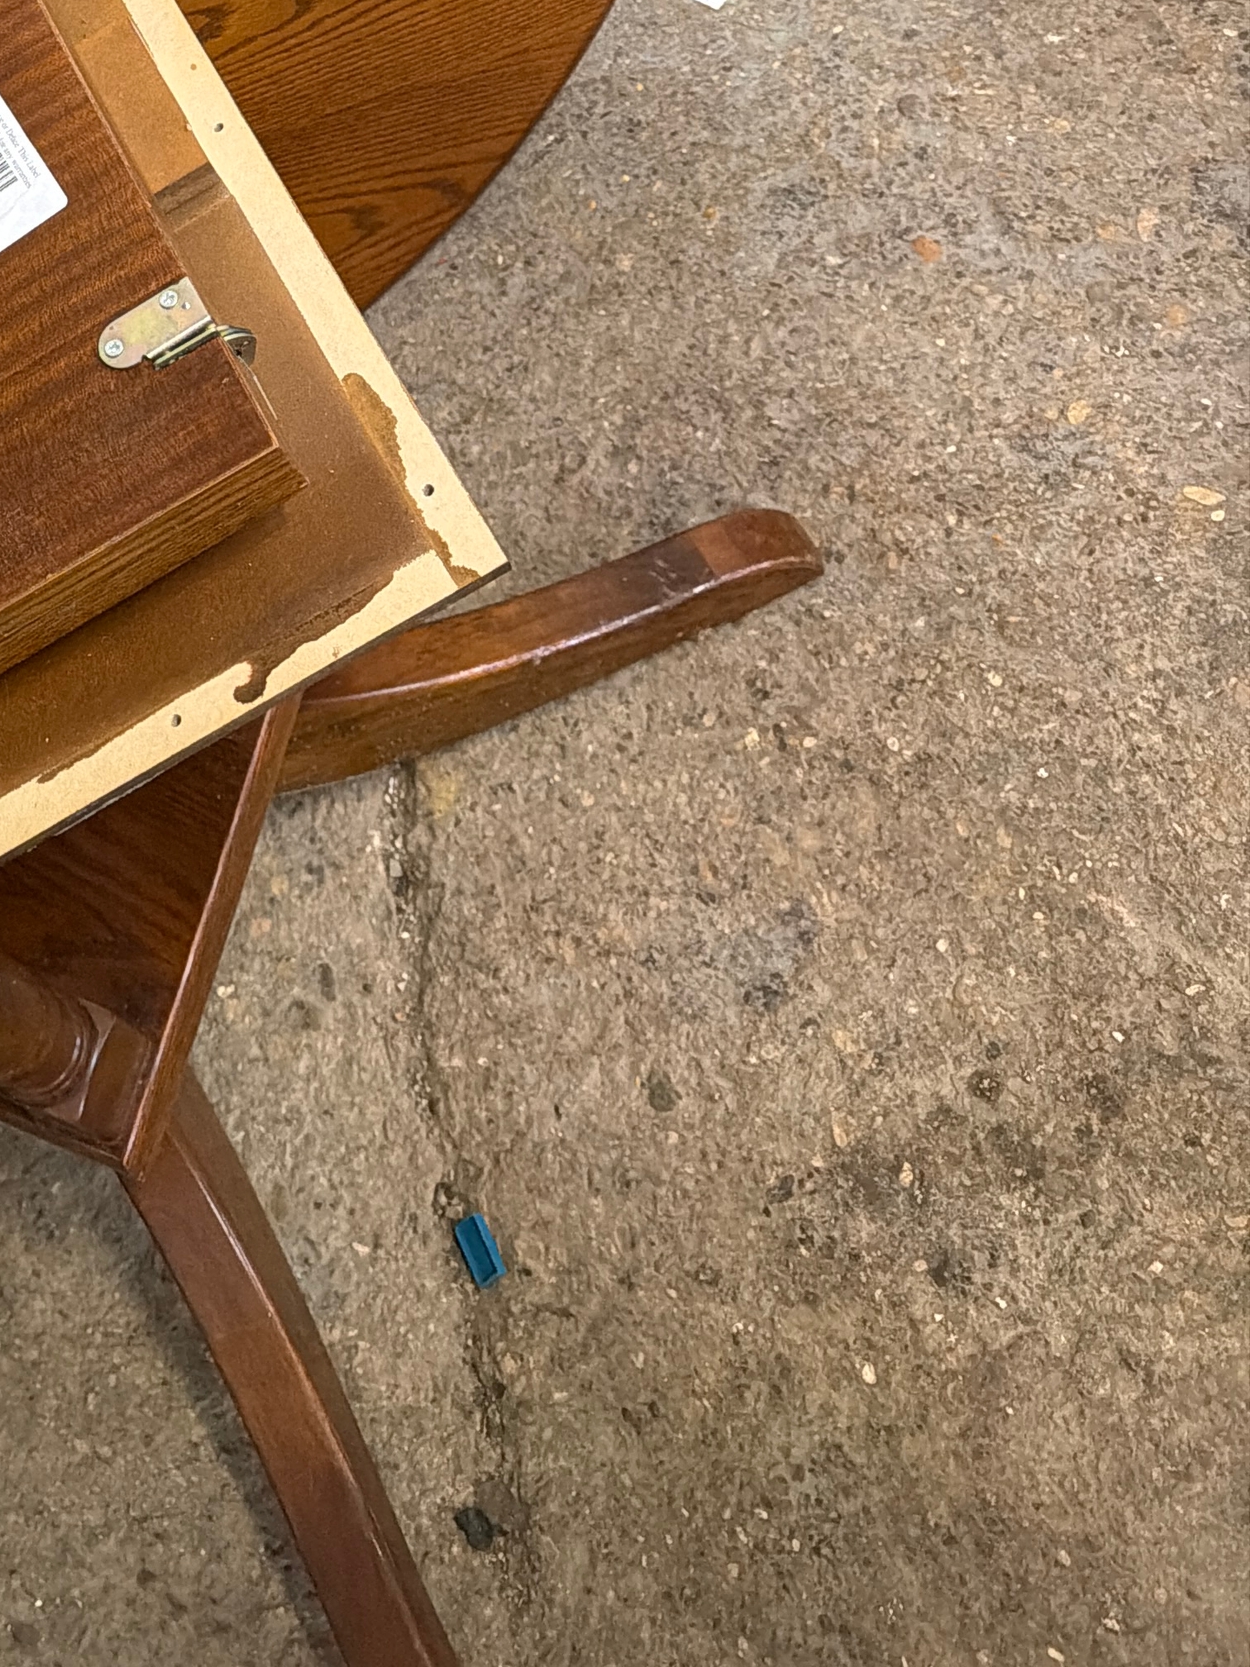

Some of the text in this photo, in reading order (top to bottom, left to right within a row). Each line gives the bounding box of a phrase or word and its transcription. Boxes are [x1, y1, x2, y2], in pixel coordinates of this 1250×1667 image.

[3, 148, 13, 159] any
[6, 128, 19, 148] Deface
[18, 146, 29, 162] This
[26, 161, 41, 178] Label
